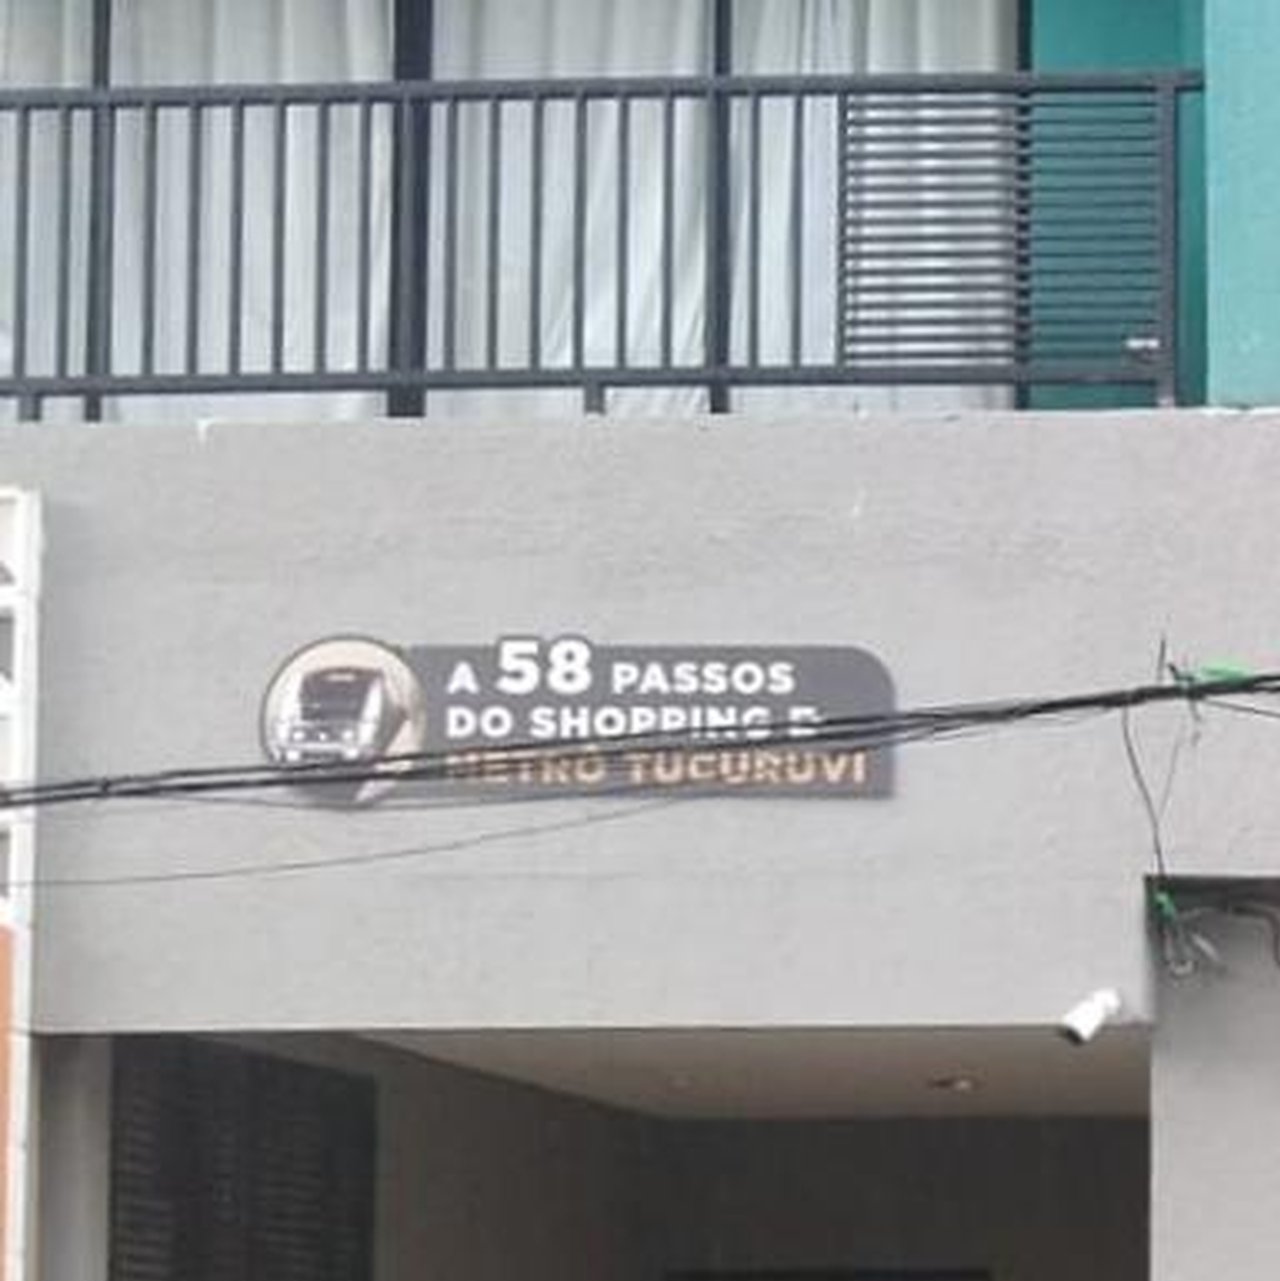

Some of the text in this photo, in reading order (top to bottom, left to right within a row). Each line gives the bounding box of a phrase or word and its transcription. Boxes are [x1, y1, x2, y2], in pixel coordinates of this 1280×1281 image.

[446, 639, 796, 694] A 58 PASSOS
[446, 706, 513, 738] DO
[530, 706, 771, 739] SHOPPING
[623, 752, 866, 783] TUCURUVI
